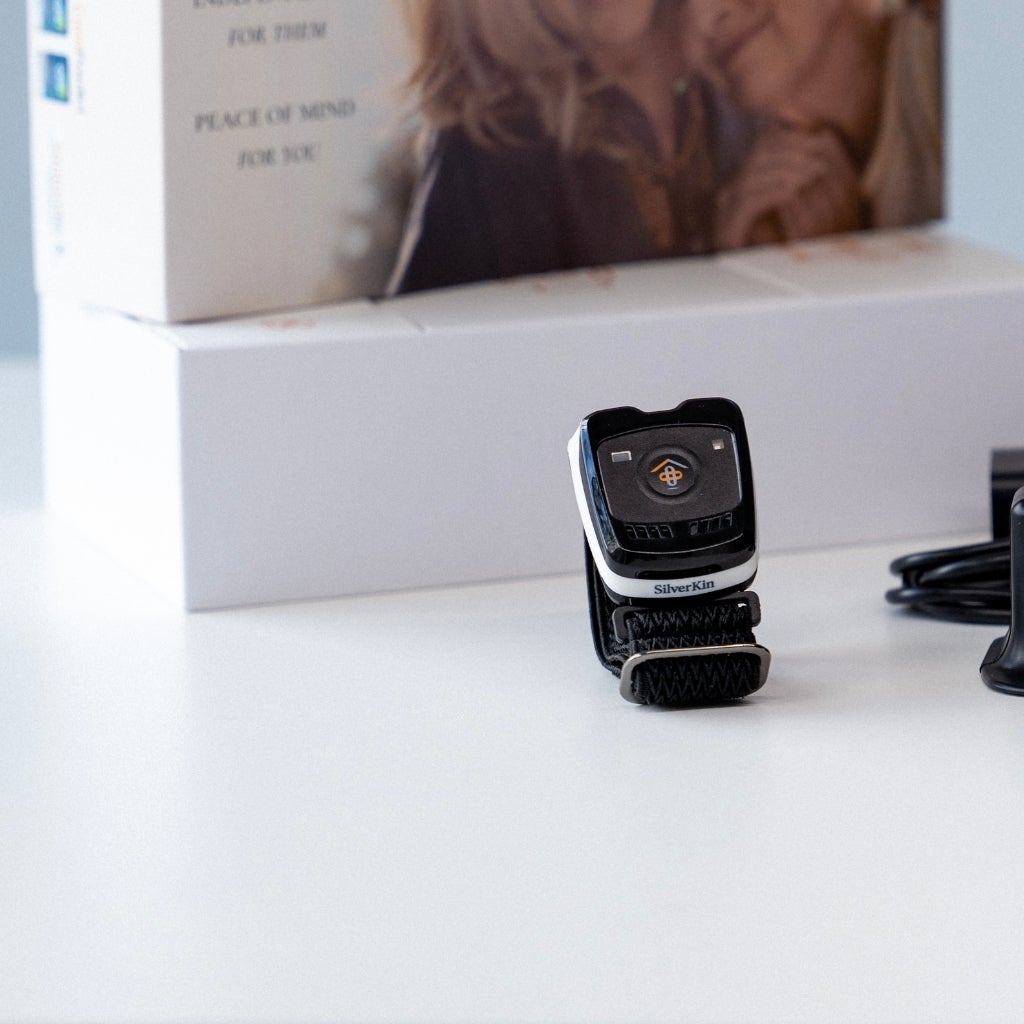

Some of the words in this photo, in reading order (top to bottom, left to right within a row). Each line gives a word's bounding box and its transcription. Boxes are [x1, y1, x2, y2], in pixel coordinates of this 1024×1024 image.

[228, 27, 266, 47] FOR
[194, 107, 259, 133] PEACE
[266, 104, 292, 125] OF
[299, 98, 356, 122] MIND
[238, 147, 276, 169] FOR
[654, 580, 715, 595] SilverKin
